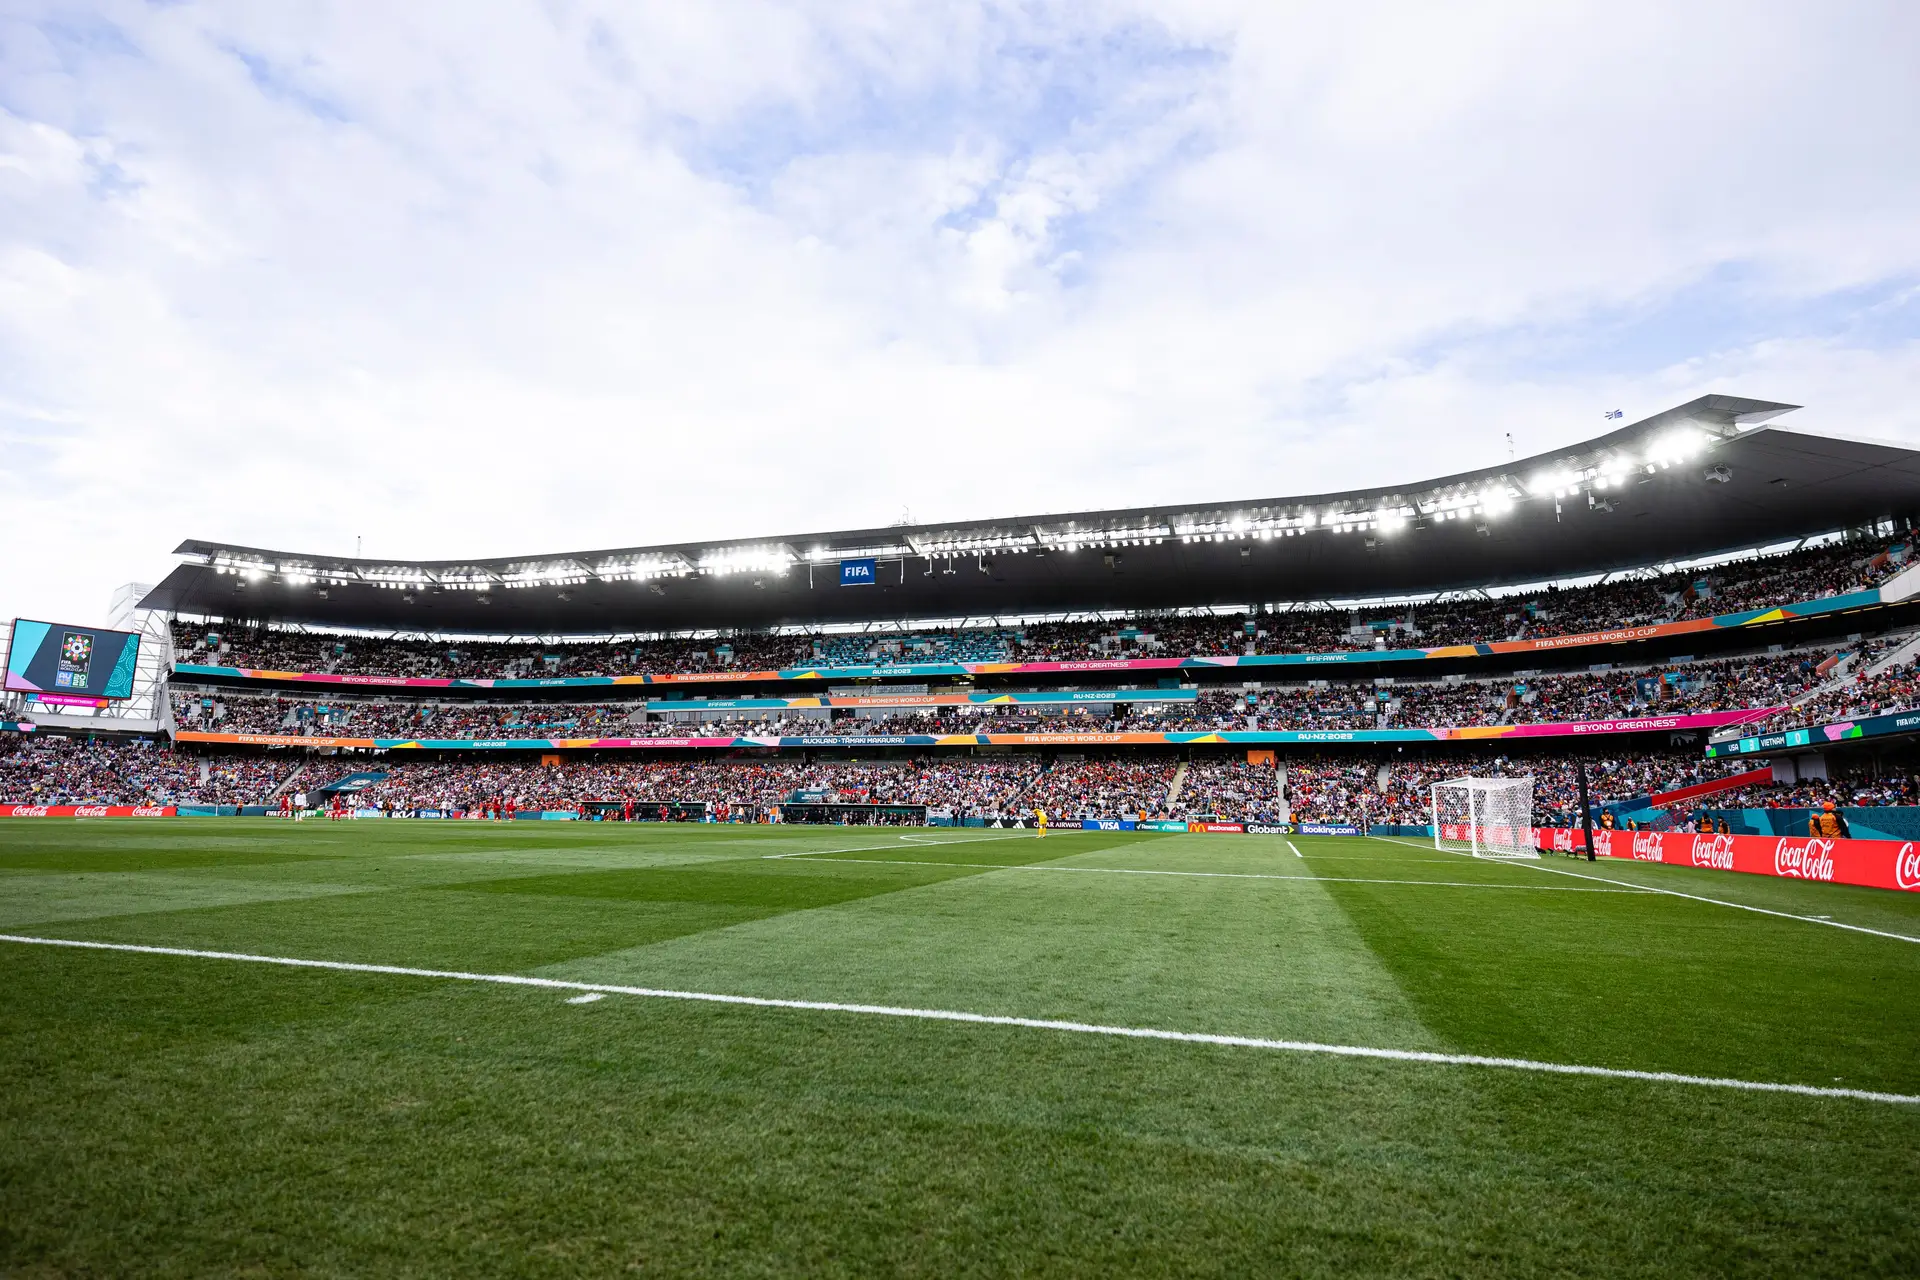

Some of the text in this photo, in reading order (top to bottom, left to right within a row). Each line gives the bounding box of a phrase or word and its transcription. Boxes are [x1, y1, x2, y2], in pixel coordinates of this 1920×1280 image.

[845, 567, 869, 577] FIFA
[1535, 628, 1657, 648] FIFA WOMEN'S WORLD CUP
[1573, 719, 1677, 733] BEYOND GREATNESS
[1896, 718, 1908, 727] FIFA
[1728, 743, 1740, 752] USA
[1761, 736, 1785, 747] VIETNAM
[1794, 731, 1802, 745] 0
[12, 805, 49, 817] Coca-Cola
[74, 805, 109, 817] Coca-Cola
[132, 806, 165, 817] Coca-Cola
[1098, 821, 1120, 830] VISA
[1247, 824, 1288, 834] Globant
[1302, 825, 1356, 835] Booking.com
[1633, 832, 1663, 862] Coca-Cola
[1692, 834, 1734, 869] Coca-Cola
[1774, 837, 1835, 881] Coca-Cola
